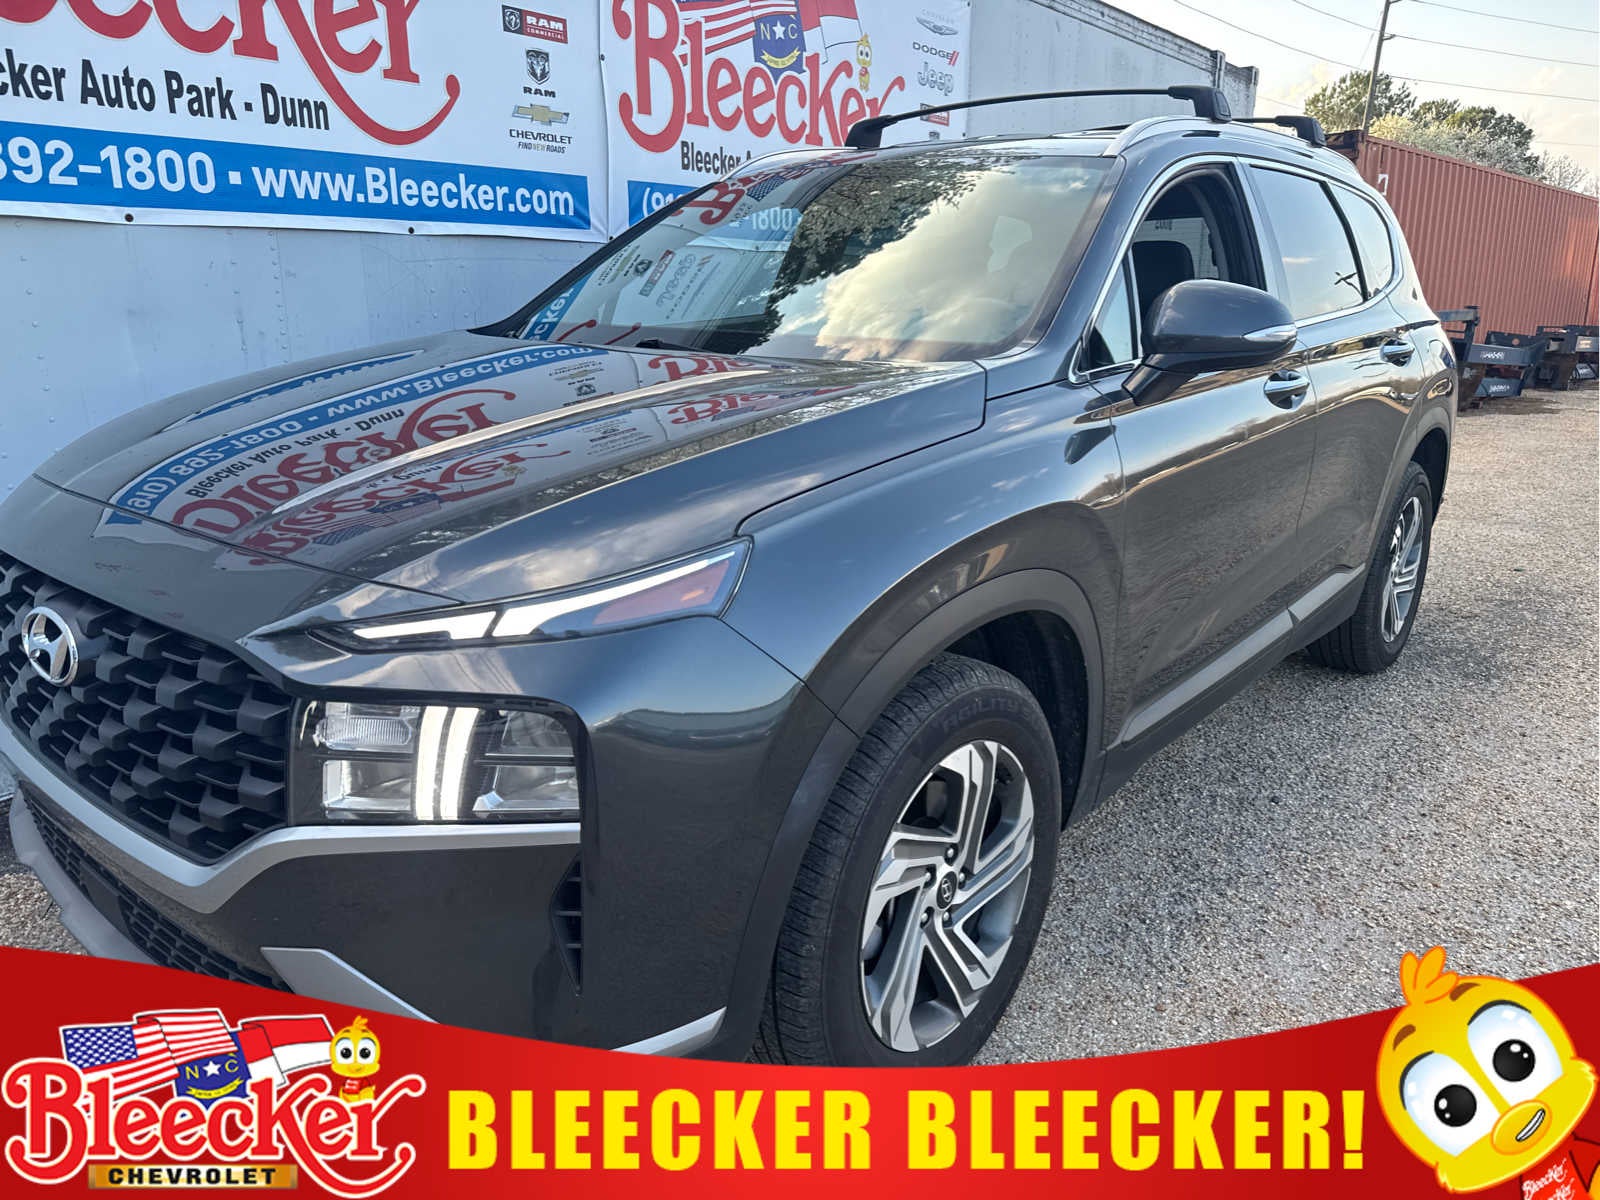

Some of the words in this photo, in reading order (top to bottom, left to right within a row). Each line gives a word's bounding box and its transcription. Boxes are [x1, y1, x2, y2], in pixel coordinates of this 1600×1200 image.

[526, 15, 564, 31] RAM
[912, 42, 952, 60] DODGE
[917, 61, 953, 96] Jeep
[80, 58, 156, 112] Auto
[163, 69, 238, 121] Park
[260, 83, 330, 131] Dunn
[523, 86, 556, 98] RAM
[509, 128, 572, 144] CHEVROLET
[518, 141, 532, 151] FIND
[546, 144, 566, 154] ROADS
[0, 136, 217, 194] 92-1800
[251, 166, 575, 217] www.Bleecker.com
[642, 187, 683, 218] (91
